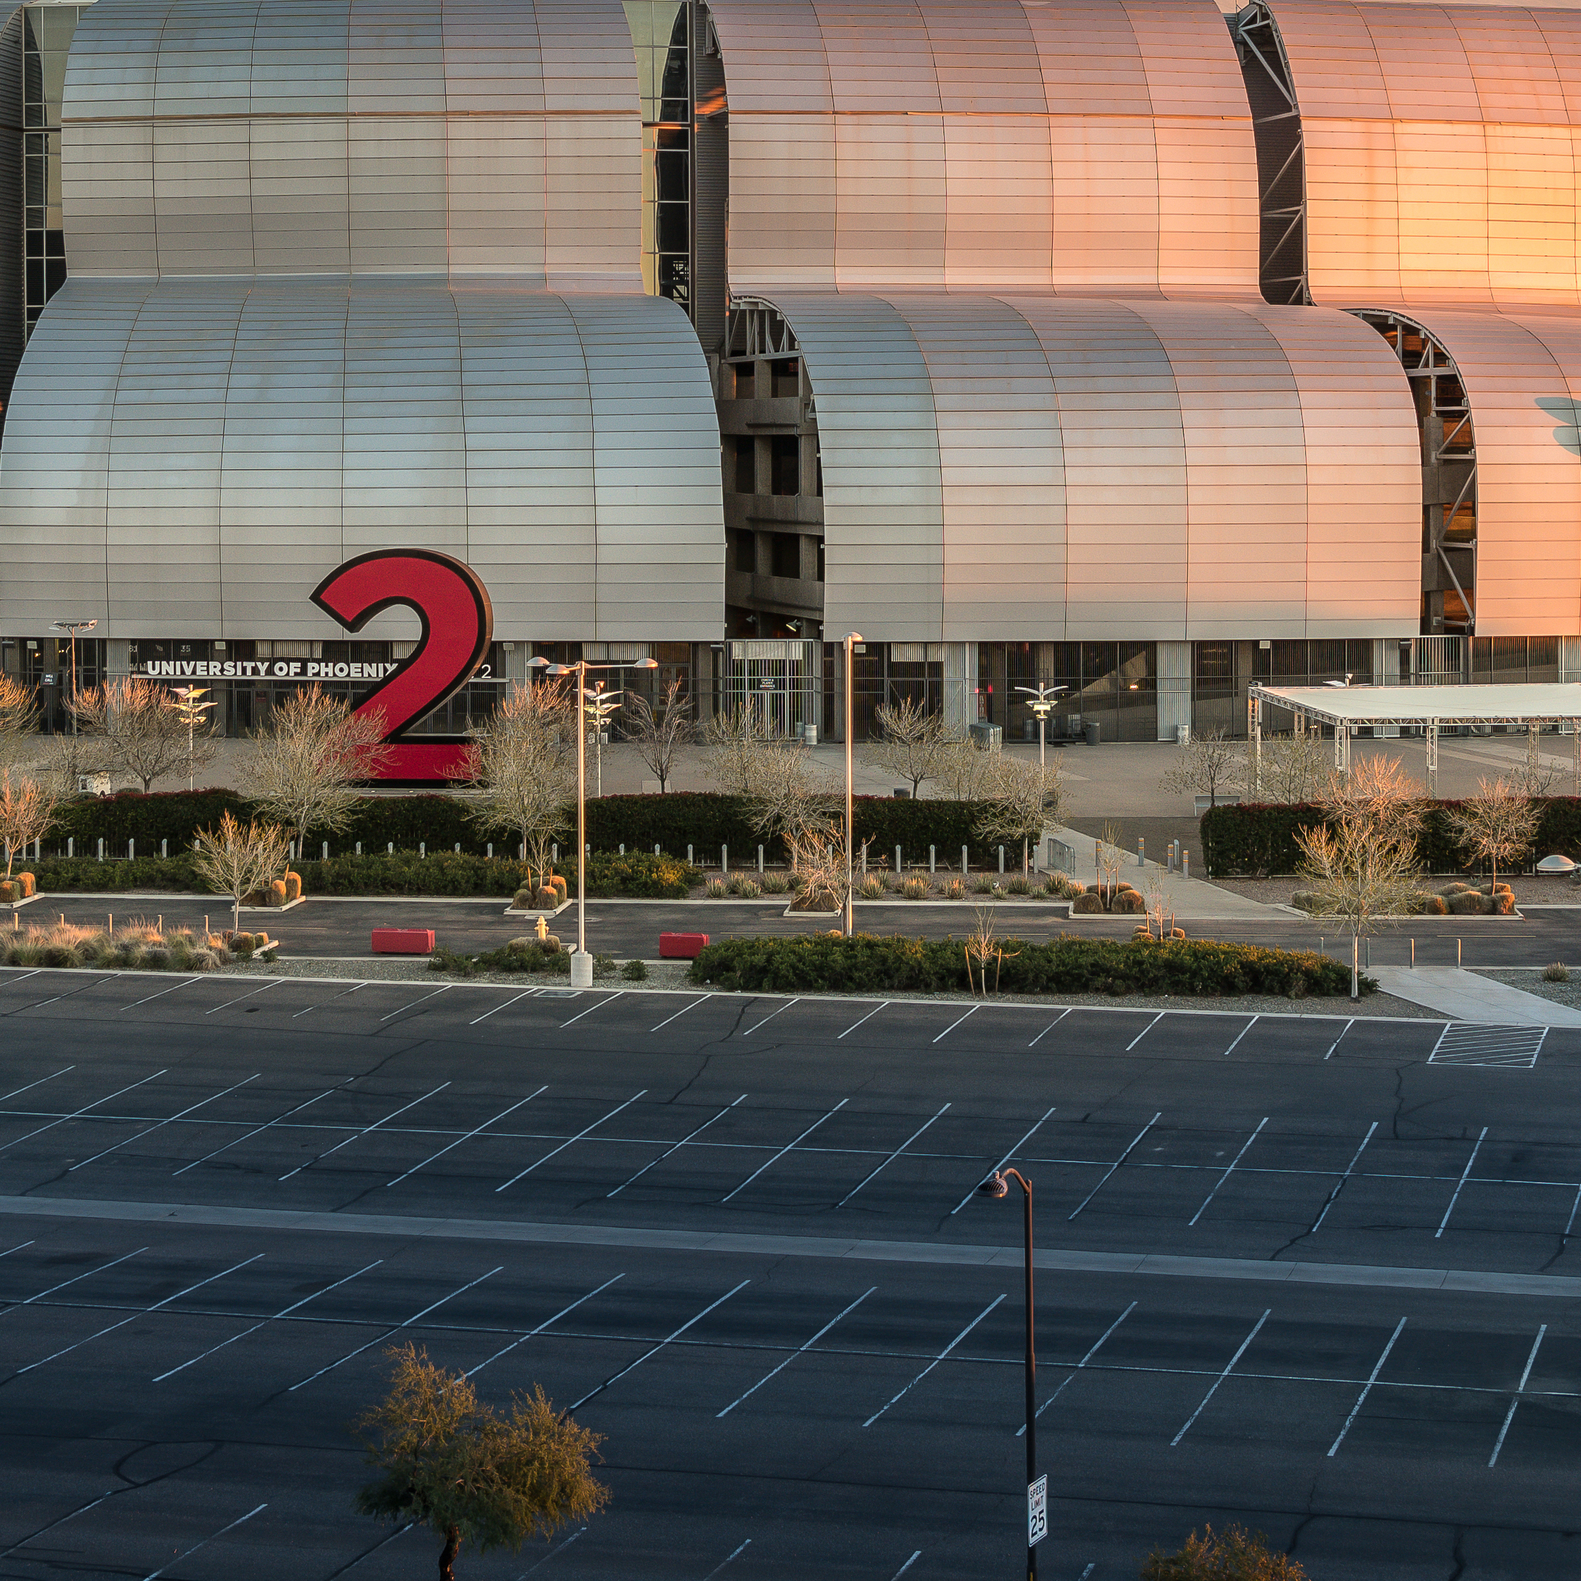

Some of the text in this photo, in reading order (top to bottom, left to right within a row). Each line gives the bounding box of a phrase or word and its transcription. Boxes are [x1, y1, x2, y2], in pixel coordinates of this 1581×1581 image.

[147, 660, 269, 676] UNIVERSITY
[273, 661, 302, 677] OF
[480, 664, 493, 679] 2
[308, 546, 494, 788] 2
[1029, 1482, 1046, 1500] SPEED
[1030, 1494, 1044, 1512] LIMIT
[1030, 1508, 1046, 1539] 25
